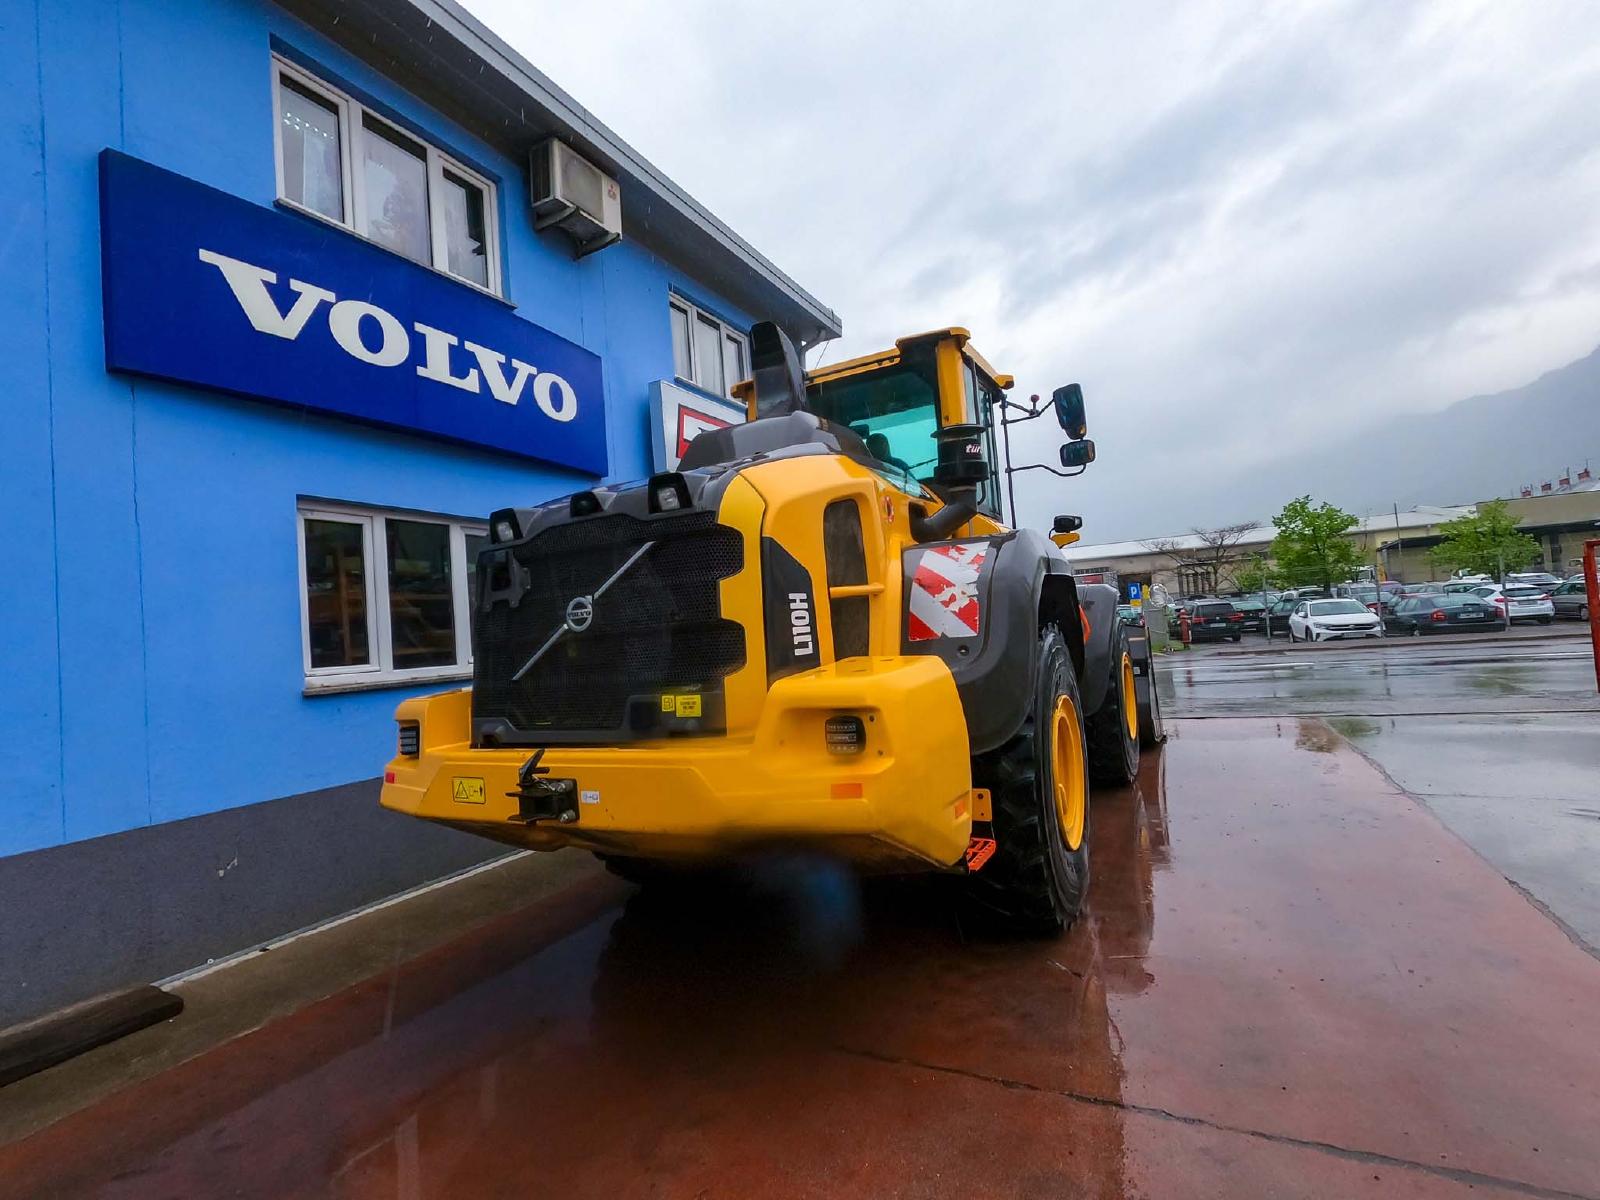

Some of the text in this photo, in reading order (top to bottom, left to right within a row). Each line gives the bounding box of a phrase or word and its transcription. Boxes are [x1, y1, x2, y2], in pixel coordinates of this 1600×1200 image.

[199, 248, 578, 422] VOLVO
[1130, 586, 1138, 599] P
[567, 610, 591, 618] VOLVO
[788, 592, 814, 656] L110H
